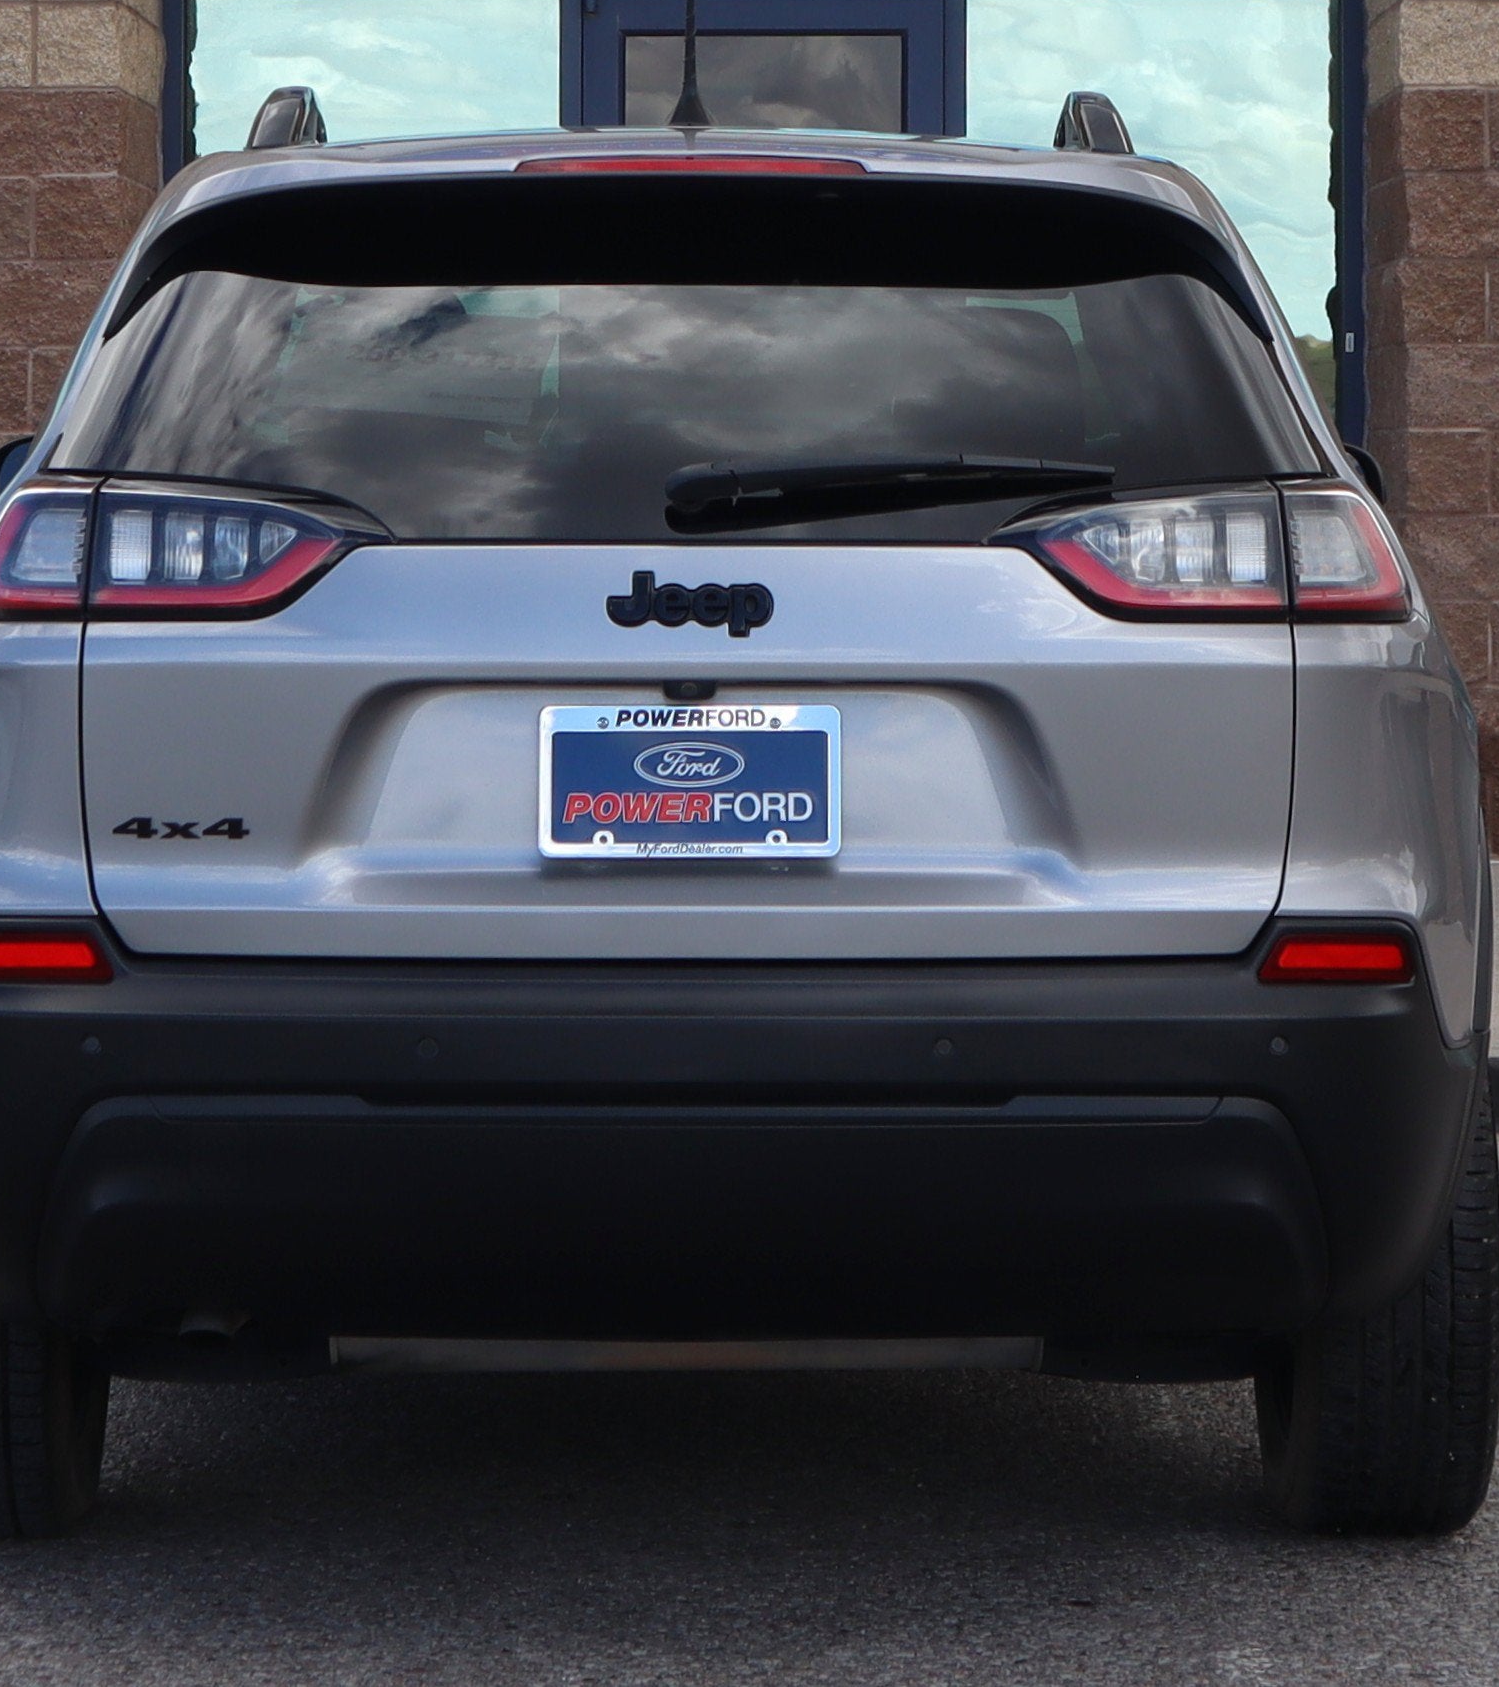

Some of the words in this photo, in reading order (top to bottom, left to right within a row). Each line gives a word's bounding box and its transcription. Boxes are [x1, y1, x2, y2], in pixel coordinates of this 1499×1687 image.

[606, 570, 774, 638] Jeep
[615, 708, 766, 728] POWERFORD
[656, 749, 722, 777] Ford
[562, 792, 813, 824] POWERFORD
[112, 817, 250, 840] 4x4
[636, 843, 744, 858] MyFordDealer.com
